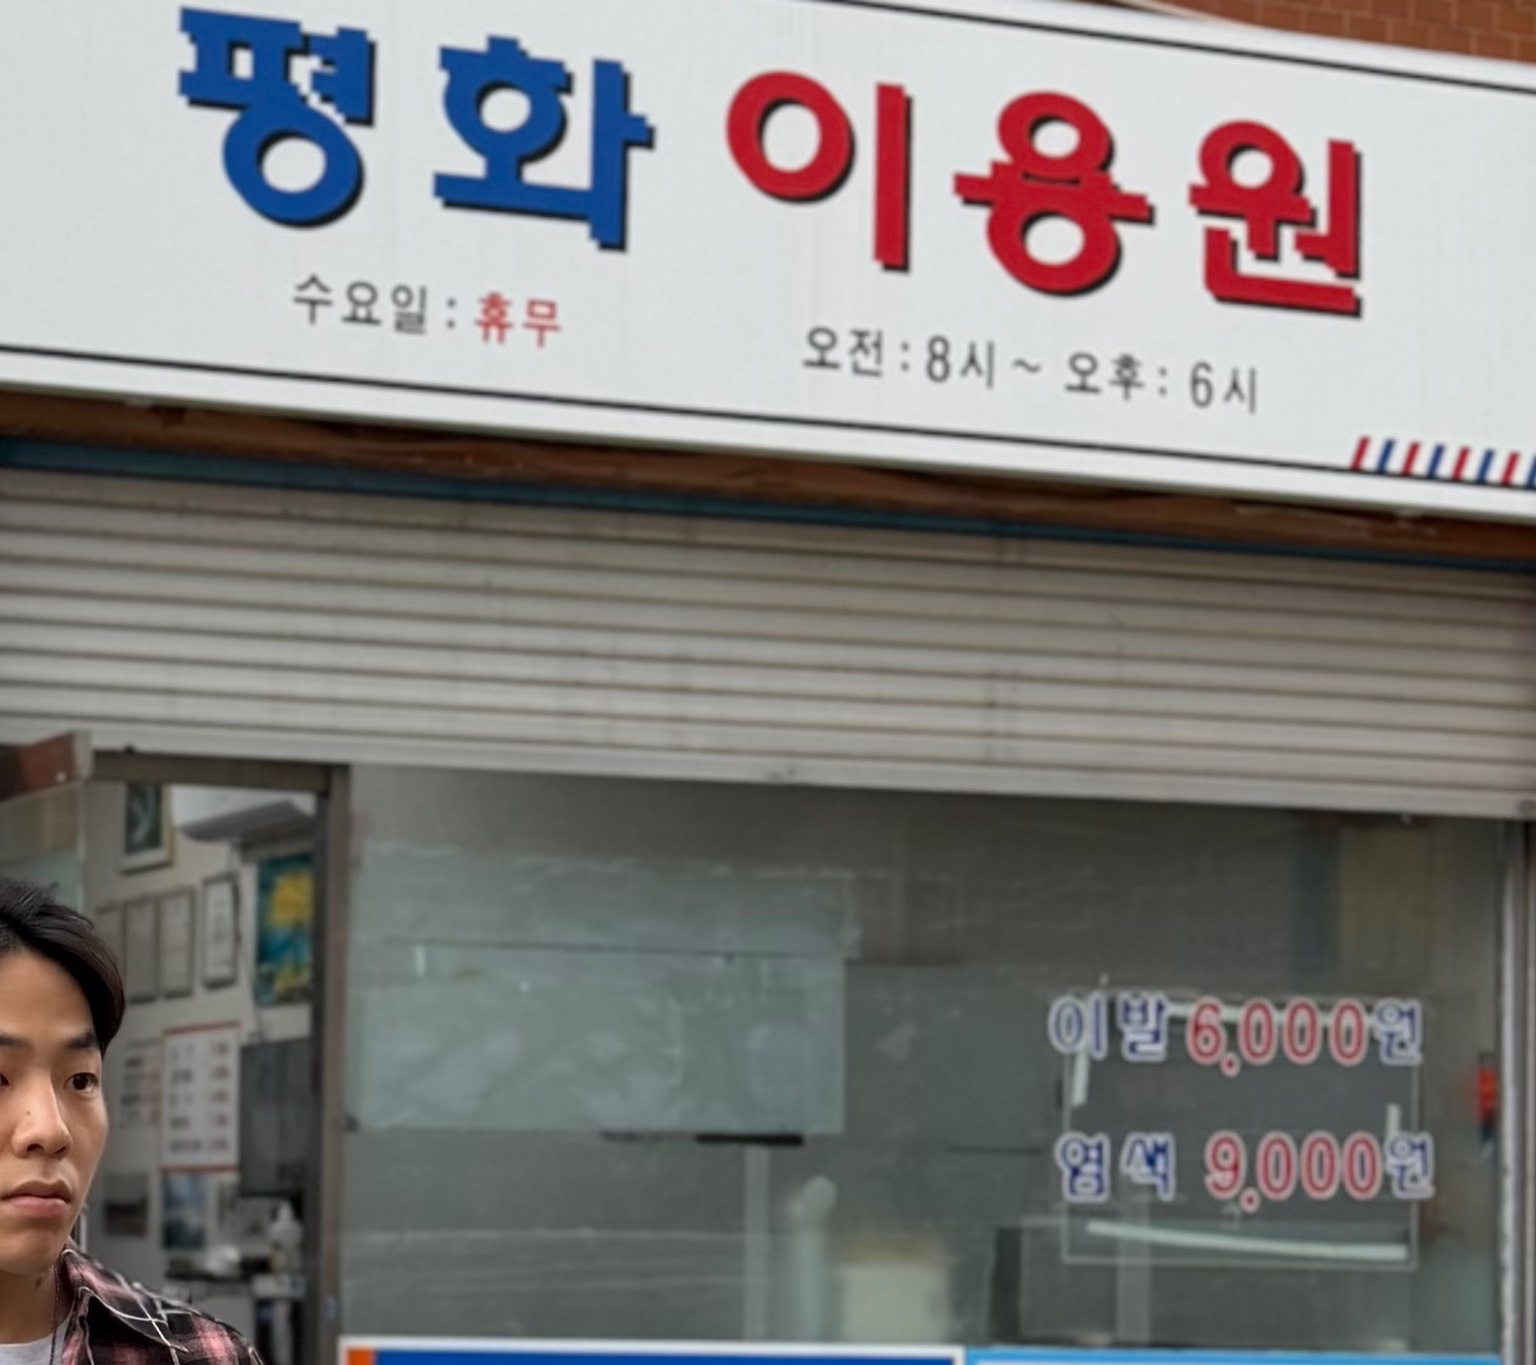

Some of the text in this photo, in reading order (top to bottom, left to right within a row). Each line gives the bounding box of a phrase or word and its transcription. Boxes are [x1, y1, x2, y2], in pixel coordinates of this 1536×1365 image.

[178, 6, 1362, 318] 평화 이용원
[1048, 991, 1168, 1061] 이발
[1055, 1131, 1176, 1202] 염색
